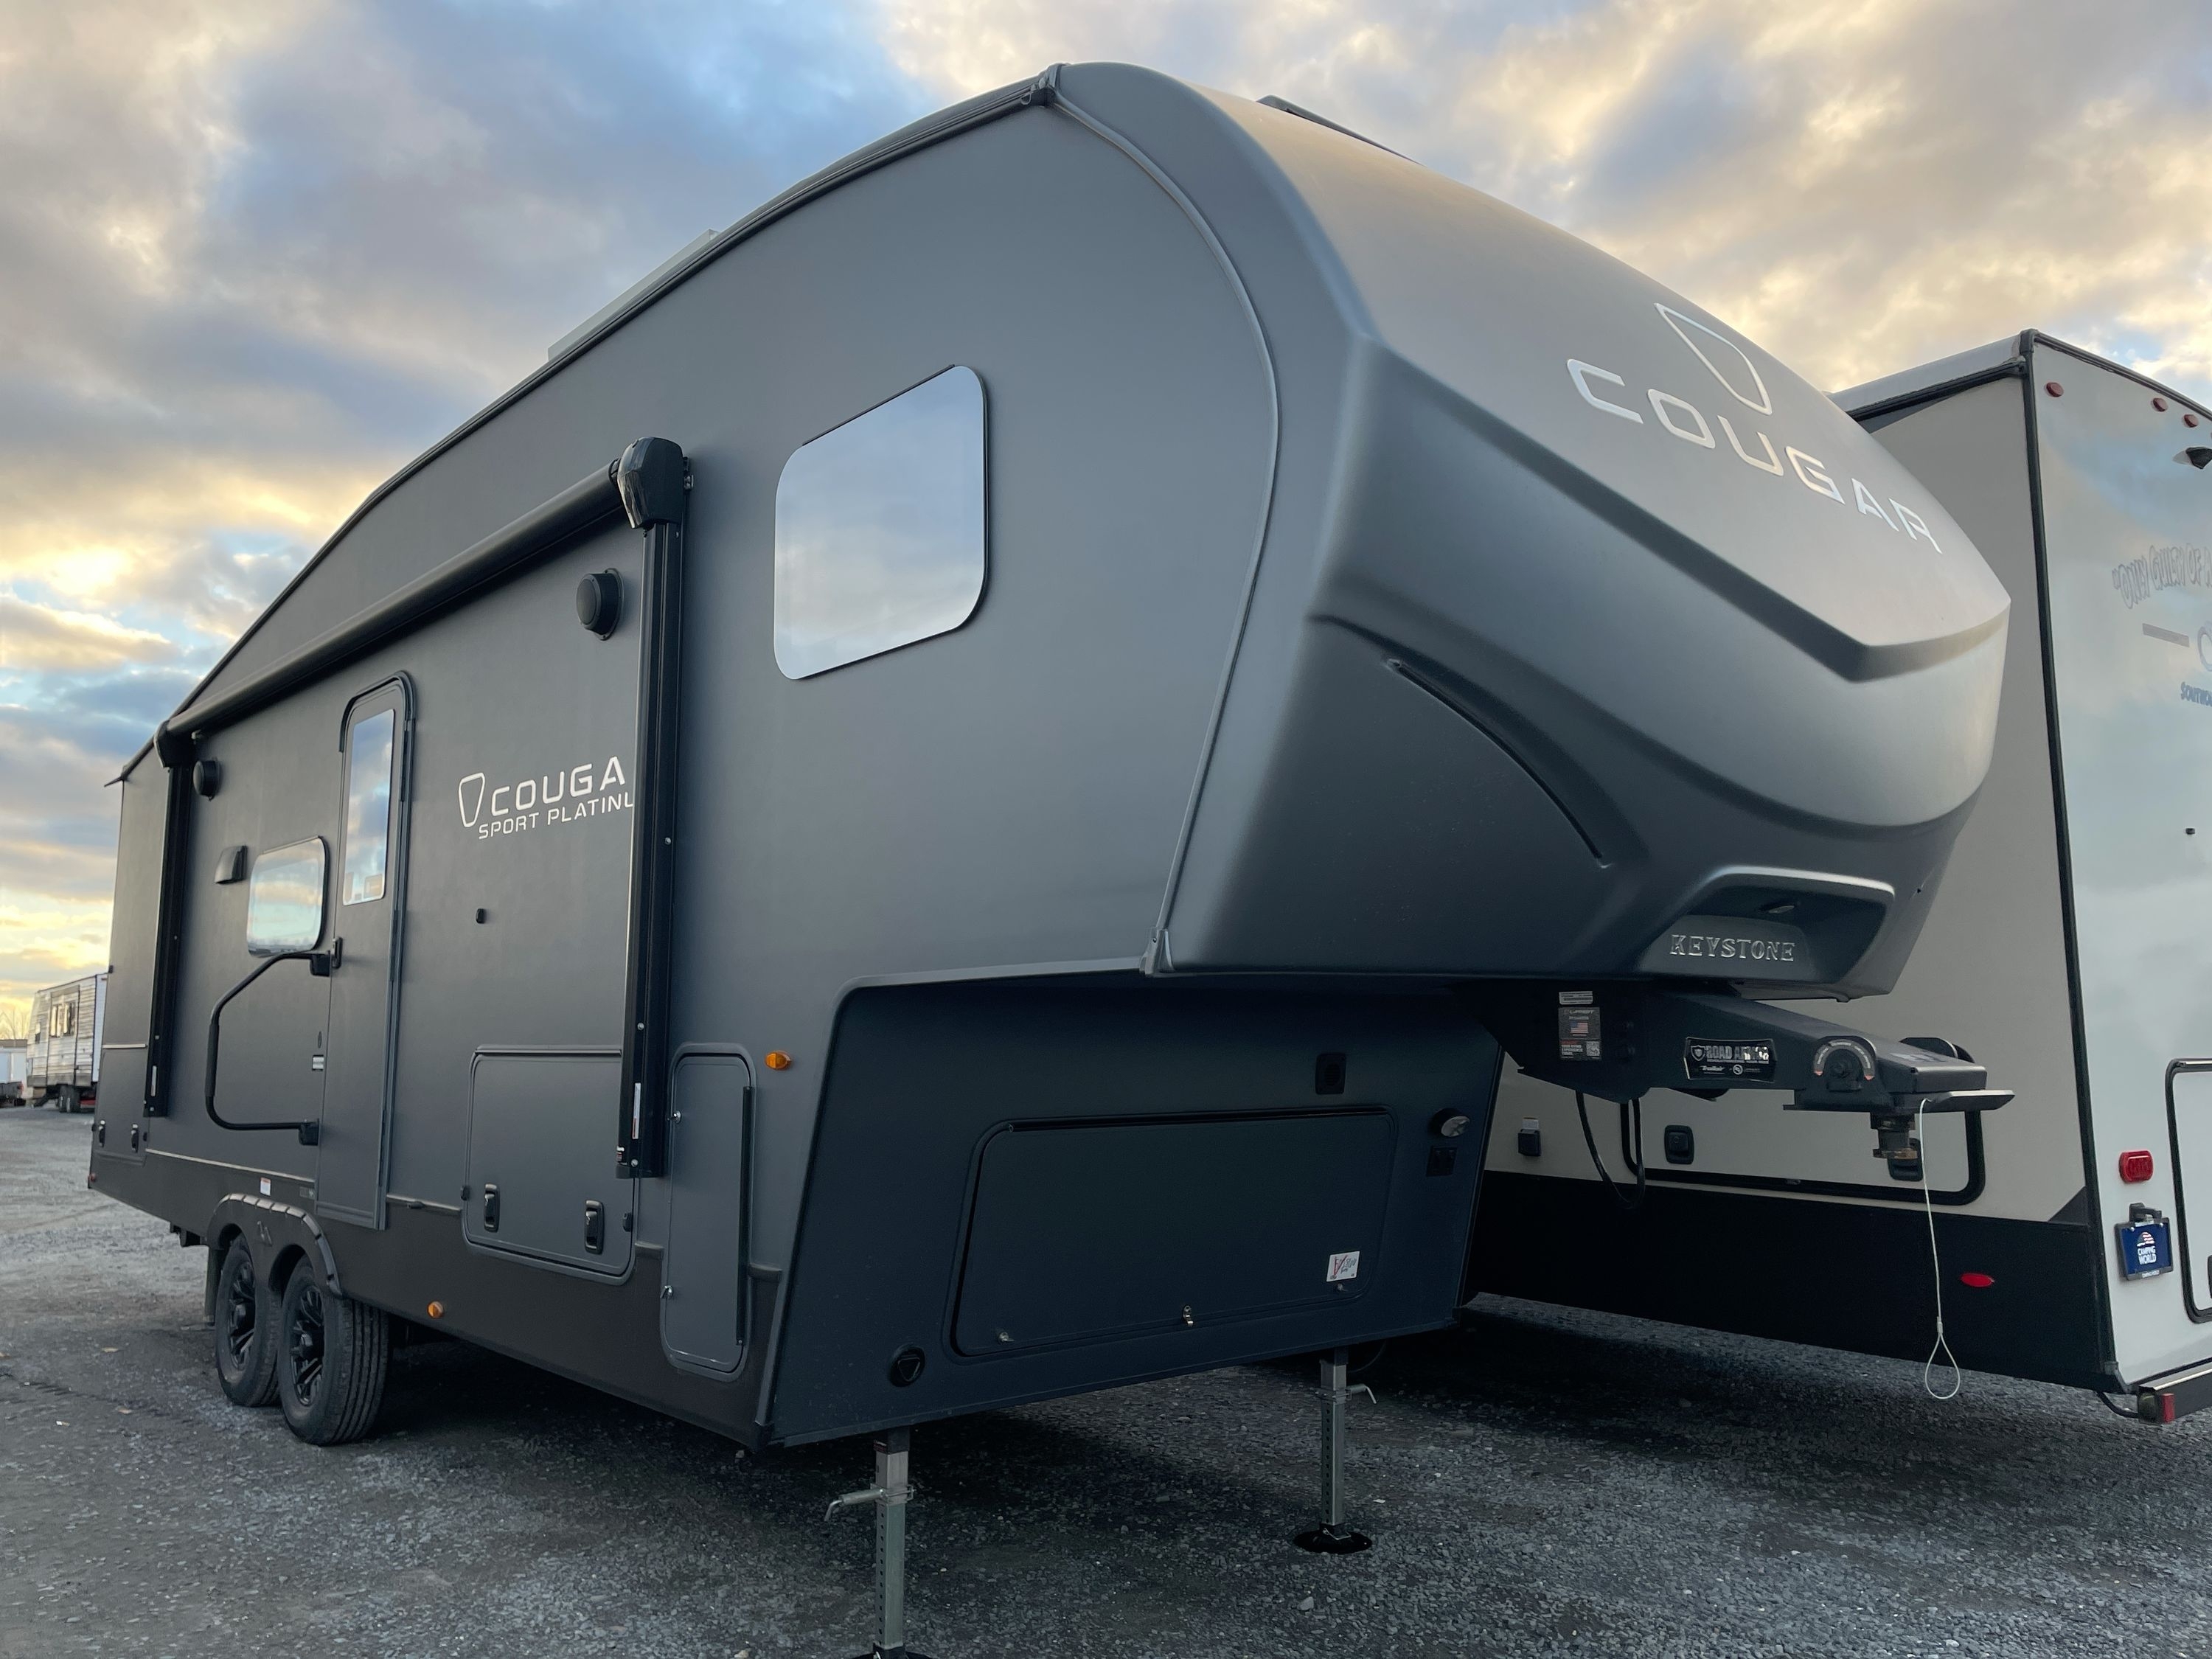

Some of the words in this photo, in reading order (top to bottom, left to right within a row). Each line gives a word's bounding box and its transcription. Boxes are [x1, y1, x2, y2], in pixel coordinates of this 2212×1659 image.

[1567, 358, 1943, 554] COUGAR
[490, 756, 626, 817] COUGA
[478, 812, 540, 840] SPORT
[547, 791, 634, 826] PLATIN
[1669, 934, 1796, 962] KEYSTONE
[2138, 1254, 2157, 1265] WORLD
